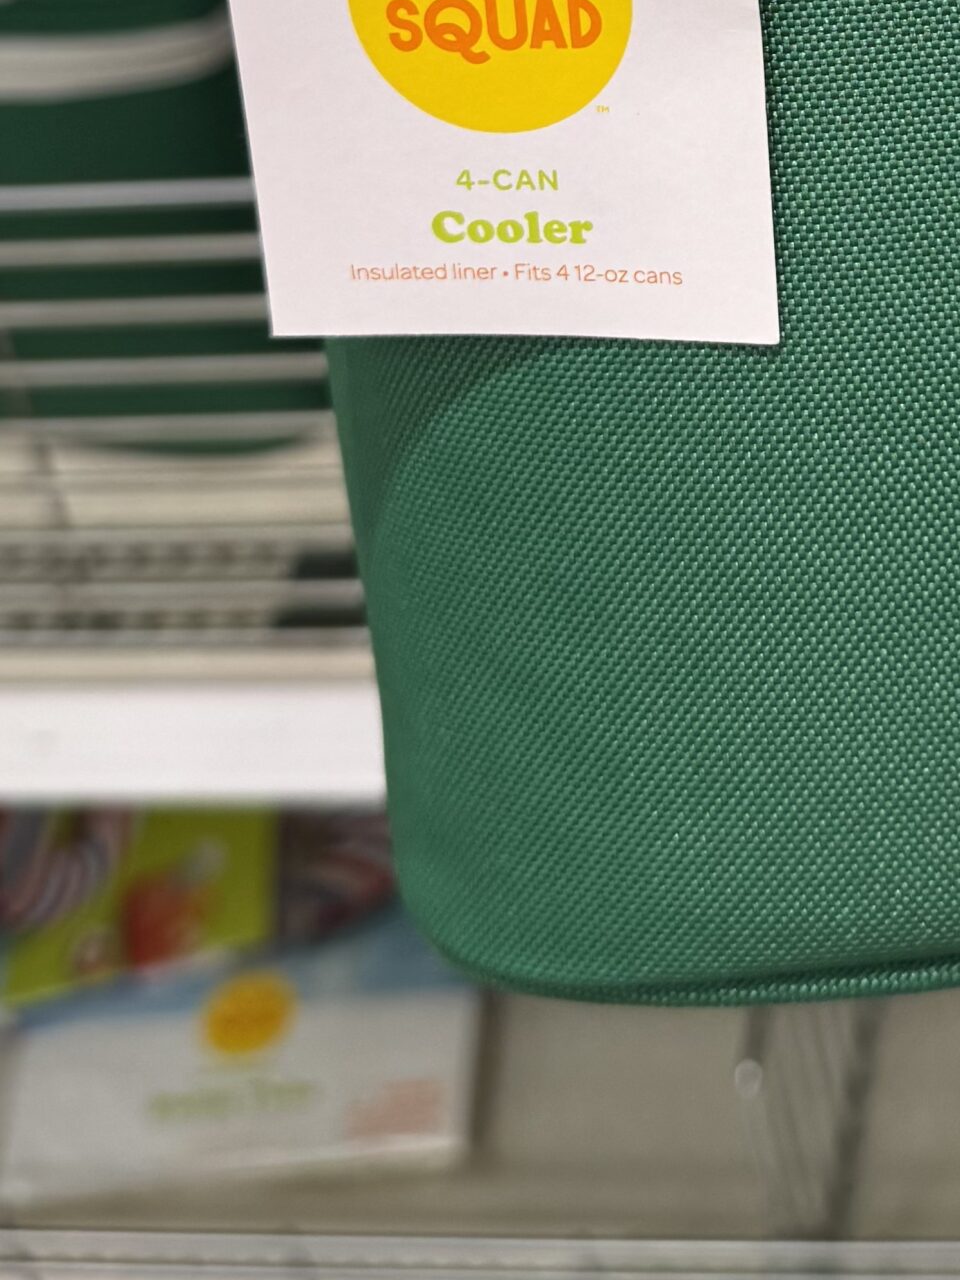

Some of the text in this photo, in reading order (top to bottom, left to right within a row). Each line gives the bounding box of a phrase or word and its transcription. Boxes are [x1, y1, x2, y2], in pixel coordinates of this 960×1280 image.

[456, 169, 560, 191] 4-CAN
[431, 211, 593, 245] Cooler
[350, 263, 683, 286] Insulated liner Fits 4 12-oz cans
